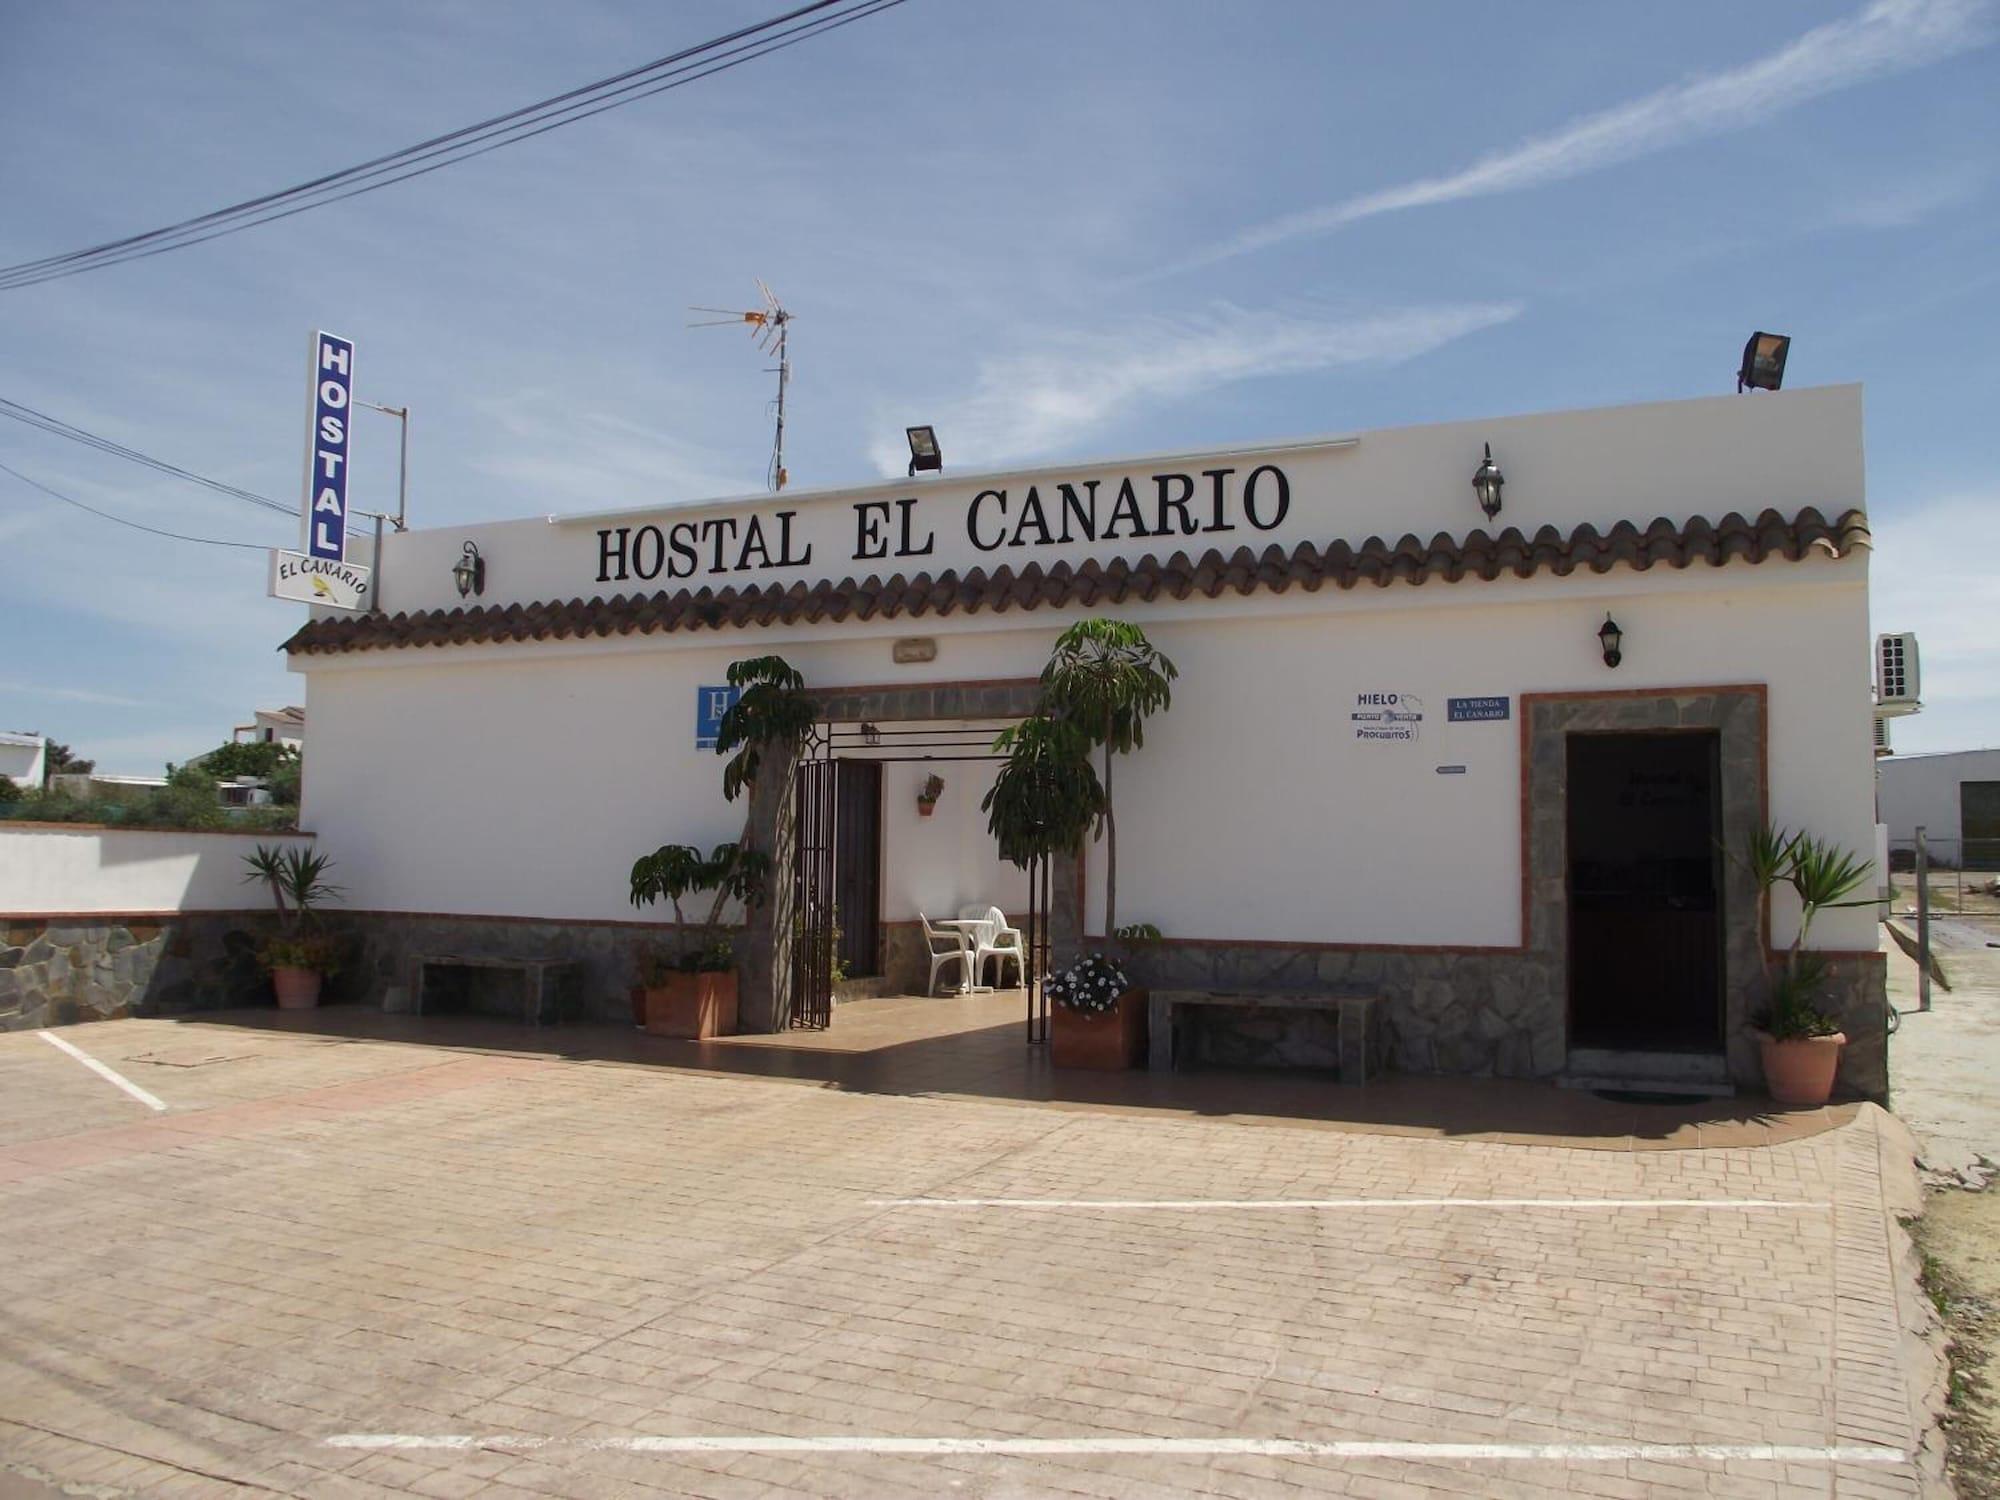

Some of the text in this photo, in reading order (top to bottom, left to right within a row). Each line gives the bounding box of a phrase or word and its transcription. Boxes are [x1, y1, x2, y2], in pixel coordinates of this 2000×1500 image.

[315, 342, 348, 552] HOSTAL
[595, 464, 1291, 583] HOSTAL EL CANARIO
[280, 559, 367, 594] EL CANARIO
[1358, 694, 1398, 705] HIELO
[1456, 699, 1501, 709] LA TIENDA
[1453, 710, 1504, 719] EL CANARIO
